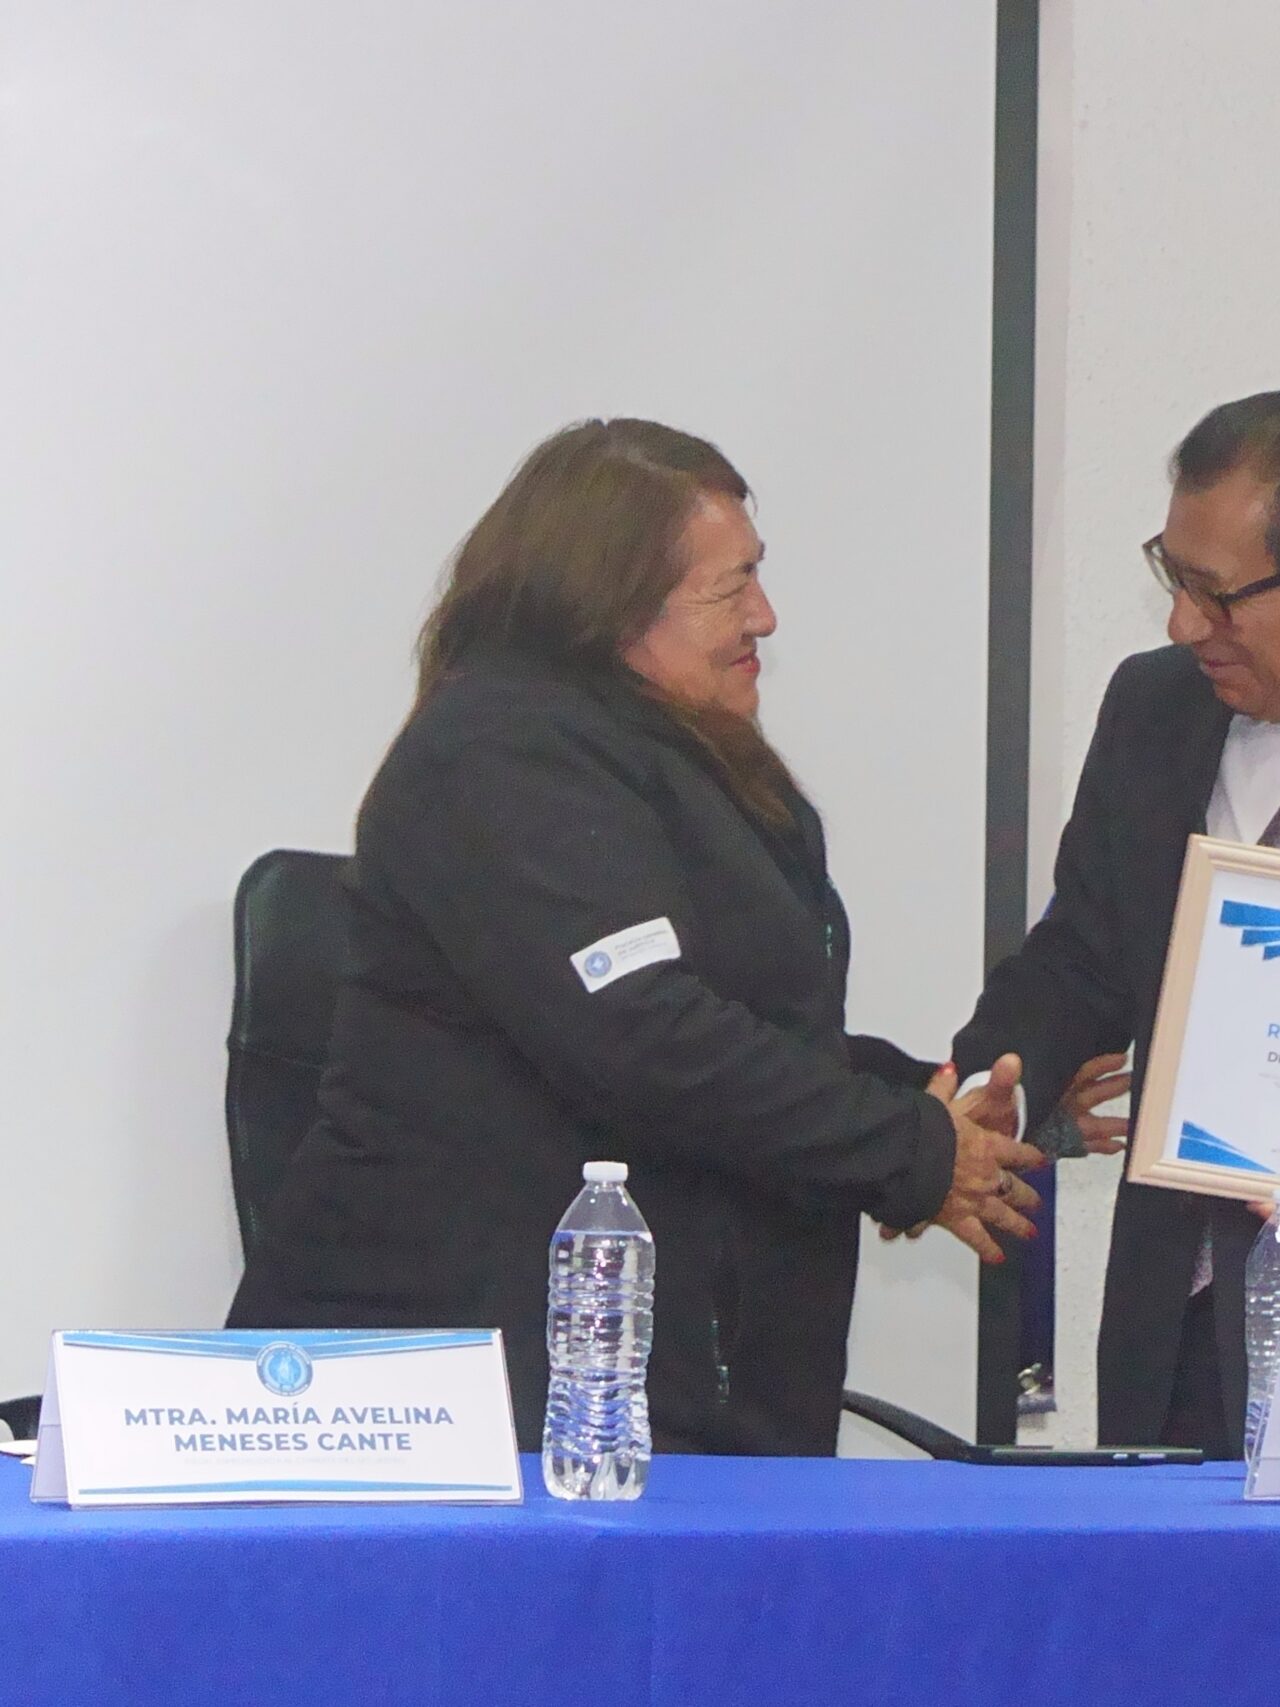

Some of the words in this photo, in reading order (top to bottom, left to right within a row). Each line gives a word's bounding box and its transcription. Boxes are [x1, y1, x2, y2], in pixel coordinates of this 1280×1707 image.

[124, 1407, 217, 1427] MTRA.
[227, 1401, 321, 1426] MARÍA
[331, 1406, 454, 1425] AVELINA
[174, 1433, 307, 1453] MENESES
[318, 1432, 413, 1452] CANTE
